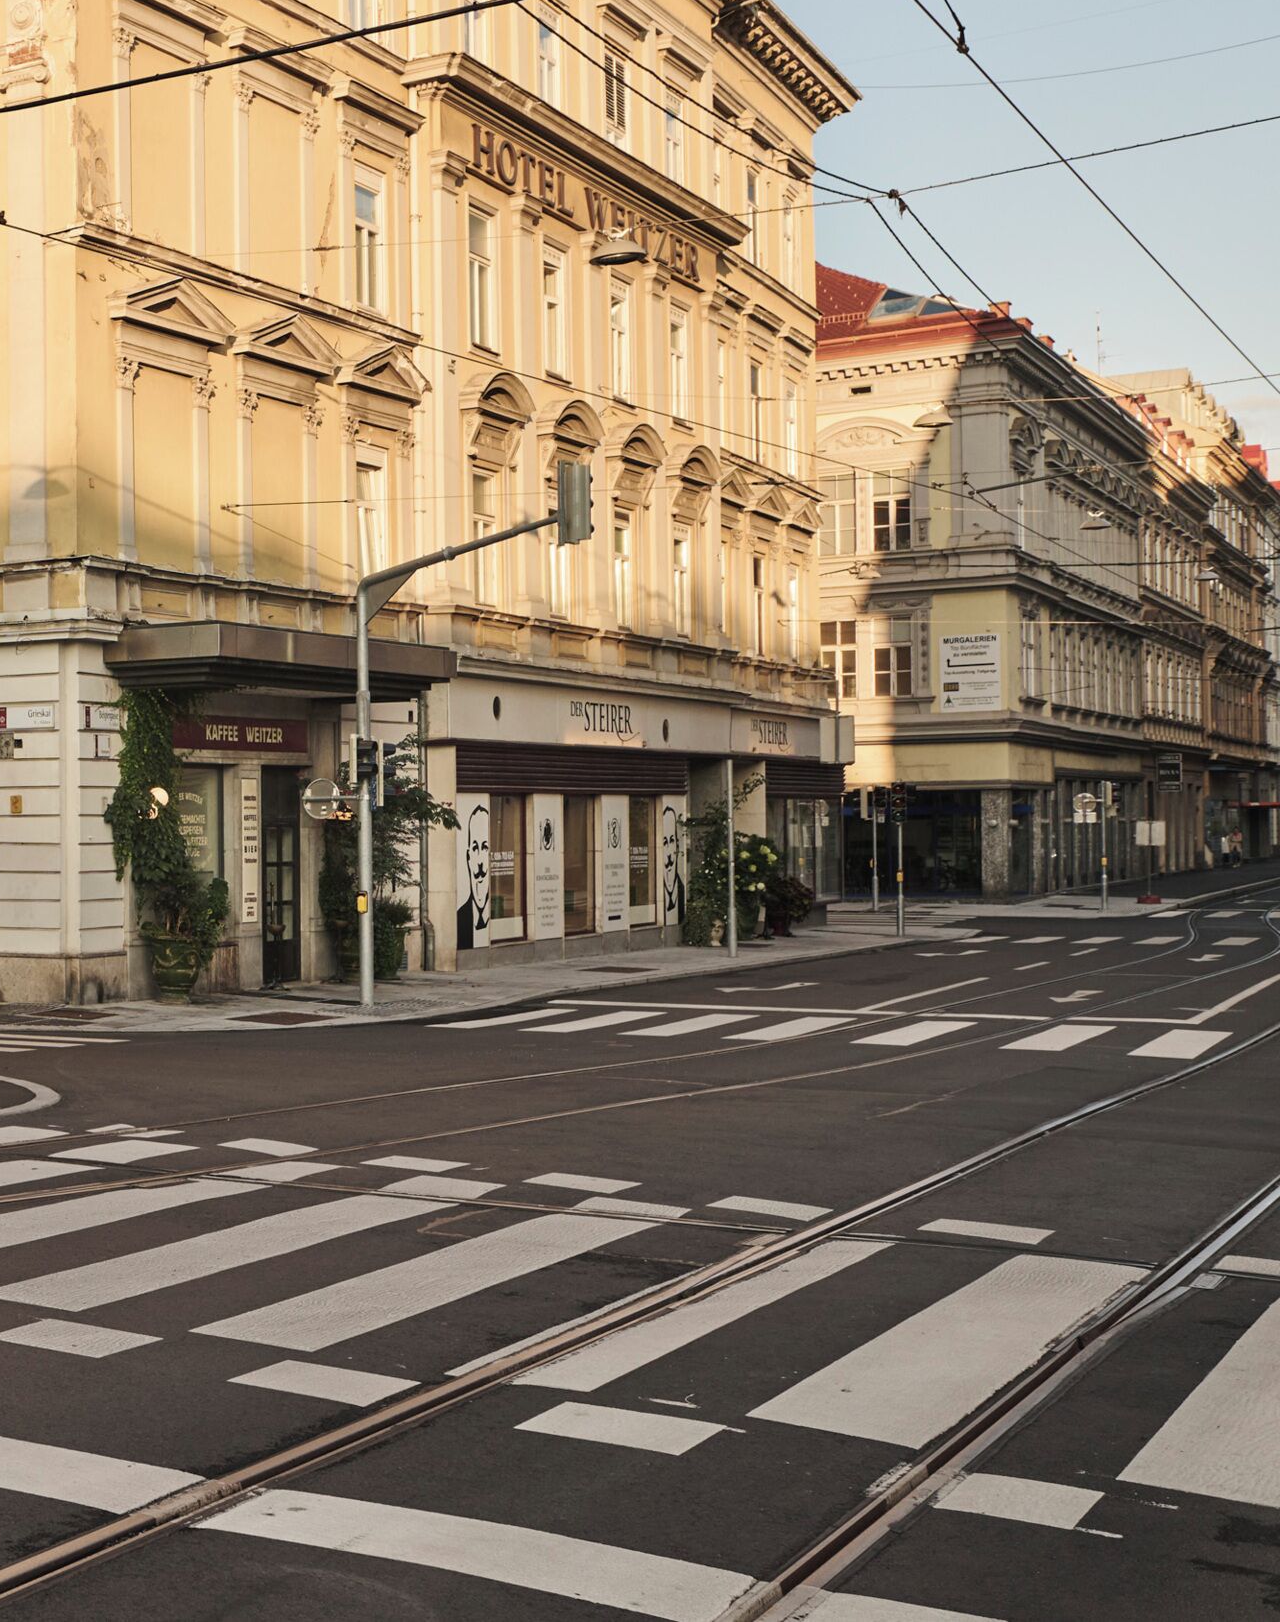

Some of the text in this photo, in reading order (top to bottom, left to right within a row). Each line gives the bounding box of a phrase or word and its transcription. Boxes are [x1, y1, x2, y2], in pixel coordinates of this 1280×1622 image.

[471, 124, 701, 283] HOTEL WEITZER
[943, 635, 997, 644] MURGALERIEN
[206, 724, 283, 743] KAFFEE WEITZER
[570, 701, 639, 741] DER STEIRER
[759, 719, 791, 751] STEIRER
